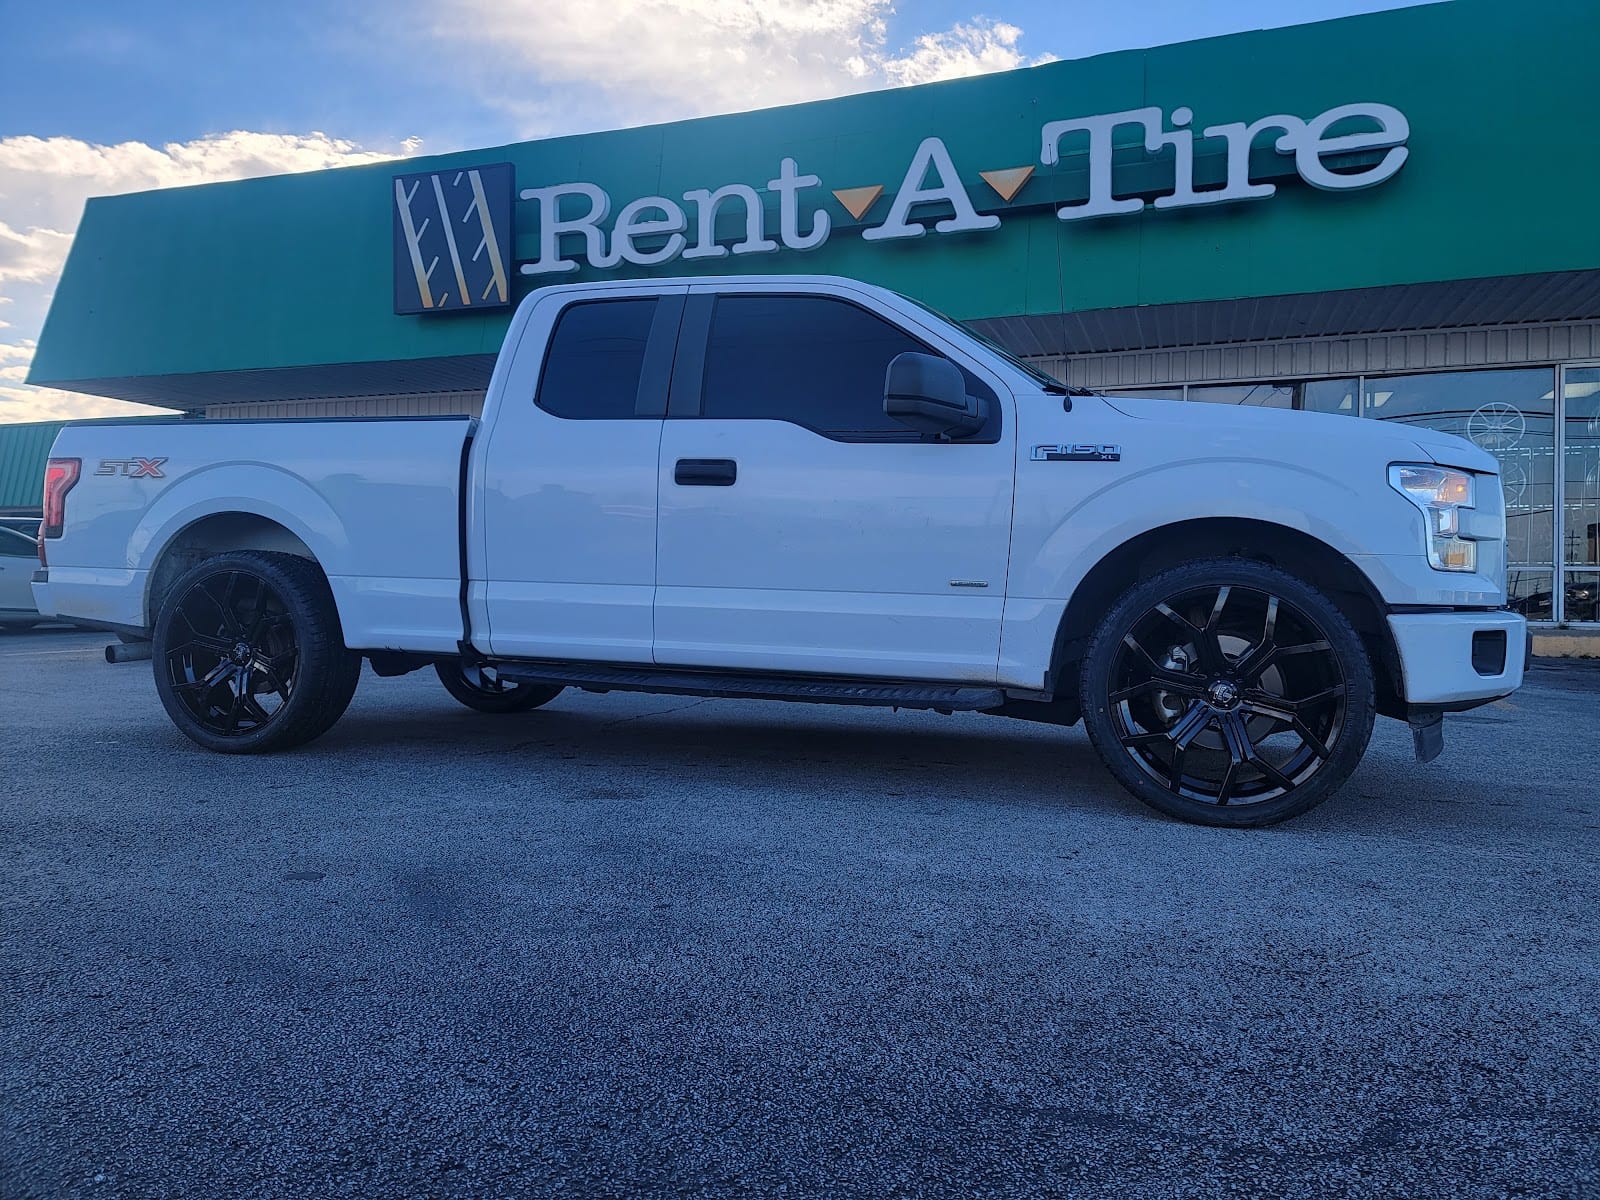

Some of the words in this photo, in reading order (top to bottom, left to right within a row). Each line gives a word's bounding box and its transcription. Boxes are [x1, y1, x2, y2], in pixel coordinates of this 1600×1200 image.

[520, 156, 832, 276] Rent
[861, 136, 1001, 241] A
[1040, 102, 1410, 222] Tire
[94, 456, 169, 478] STX
